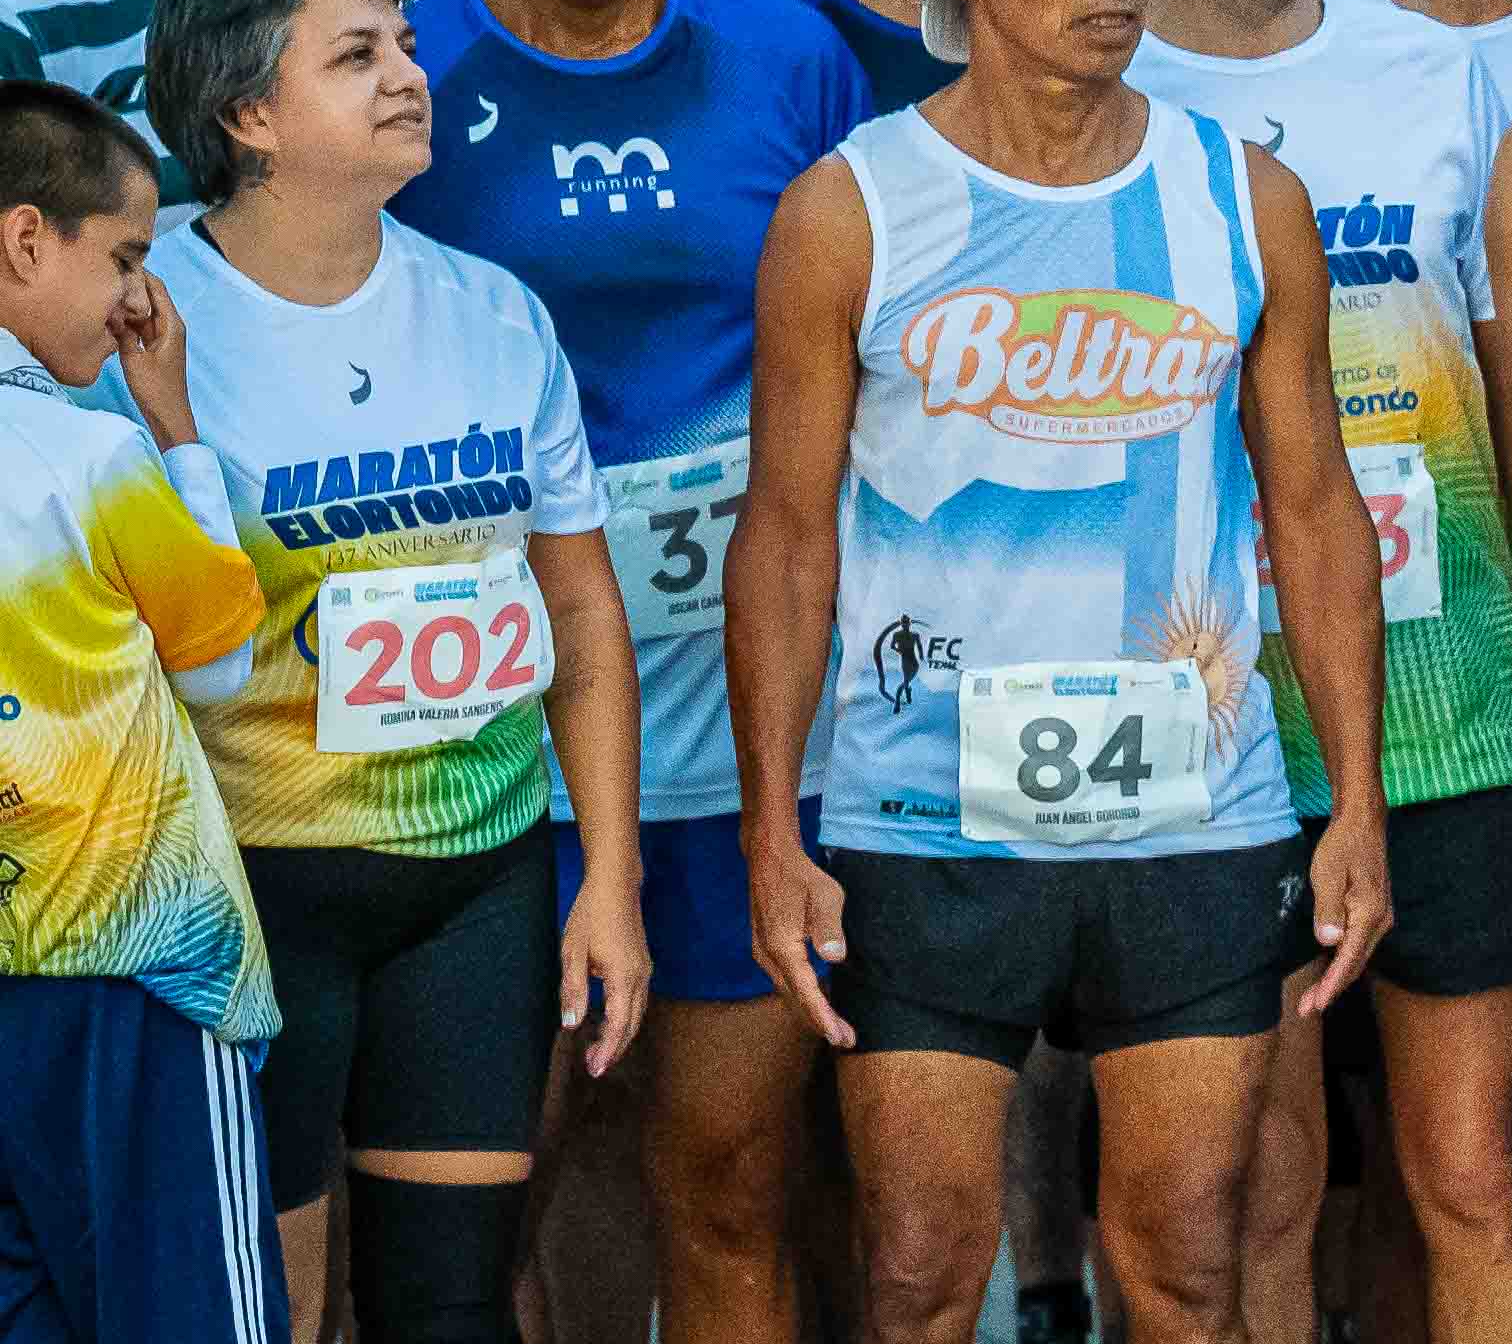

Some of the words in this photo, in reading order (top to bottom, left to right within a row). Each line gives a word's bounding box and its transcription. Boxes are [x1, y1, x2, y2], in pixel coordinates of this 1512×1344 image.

[568, 175, 657, 193] running
[260, 421, 525, 516] MARATÓN
[344, 602, 535, 706] 202
[927, 636, 964, 660] FC
[1016, 714, 1153, 804] 84
